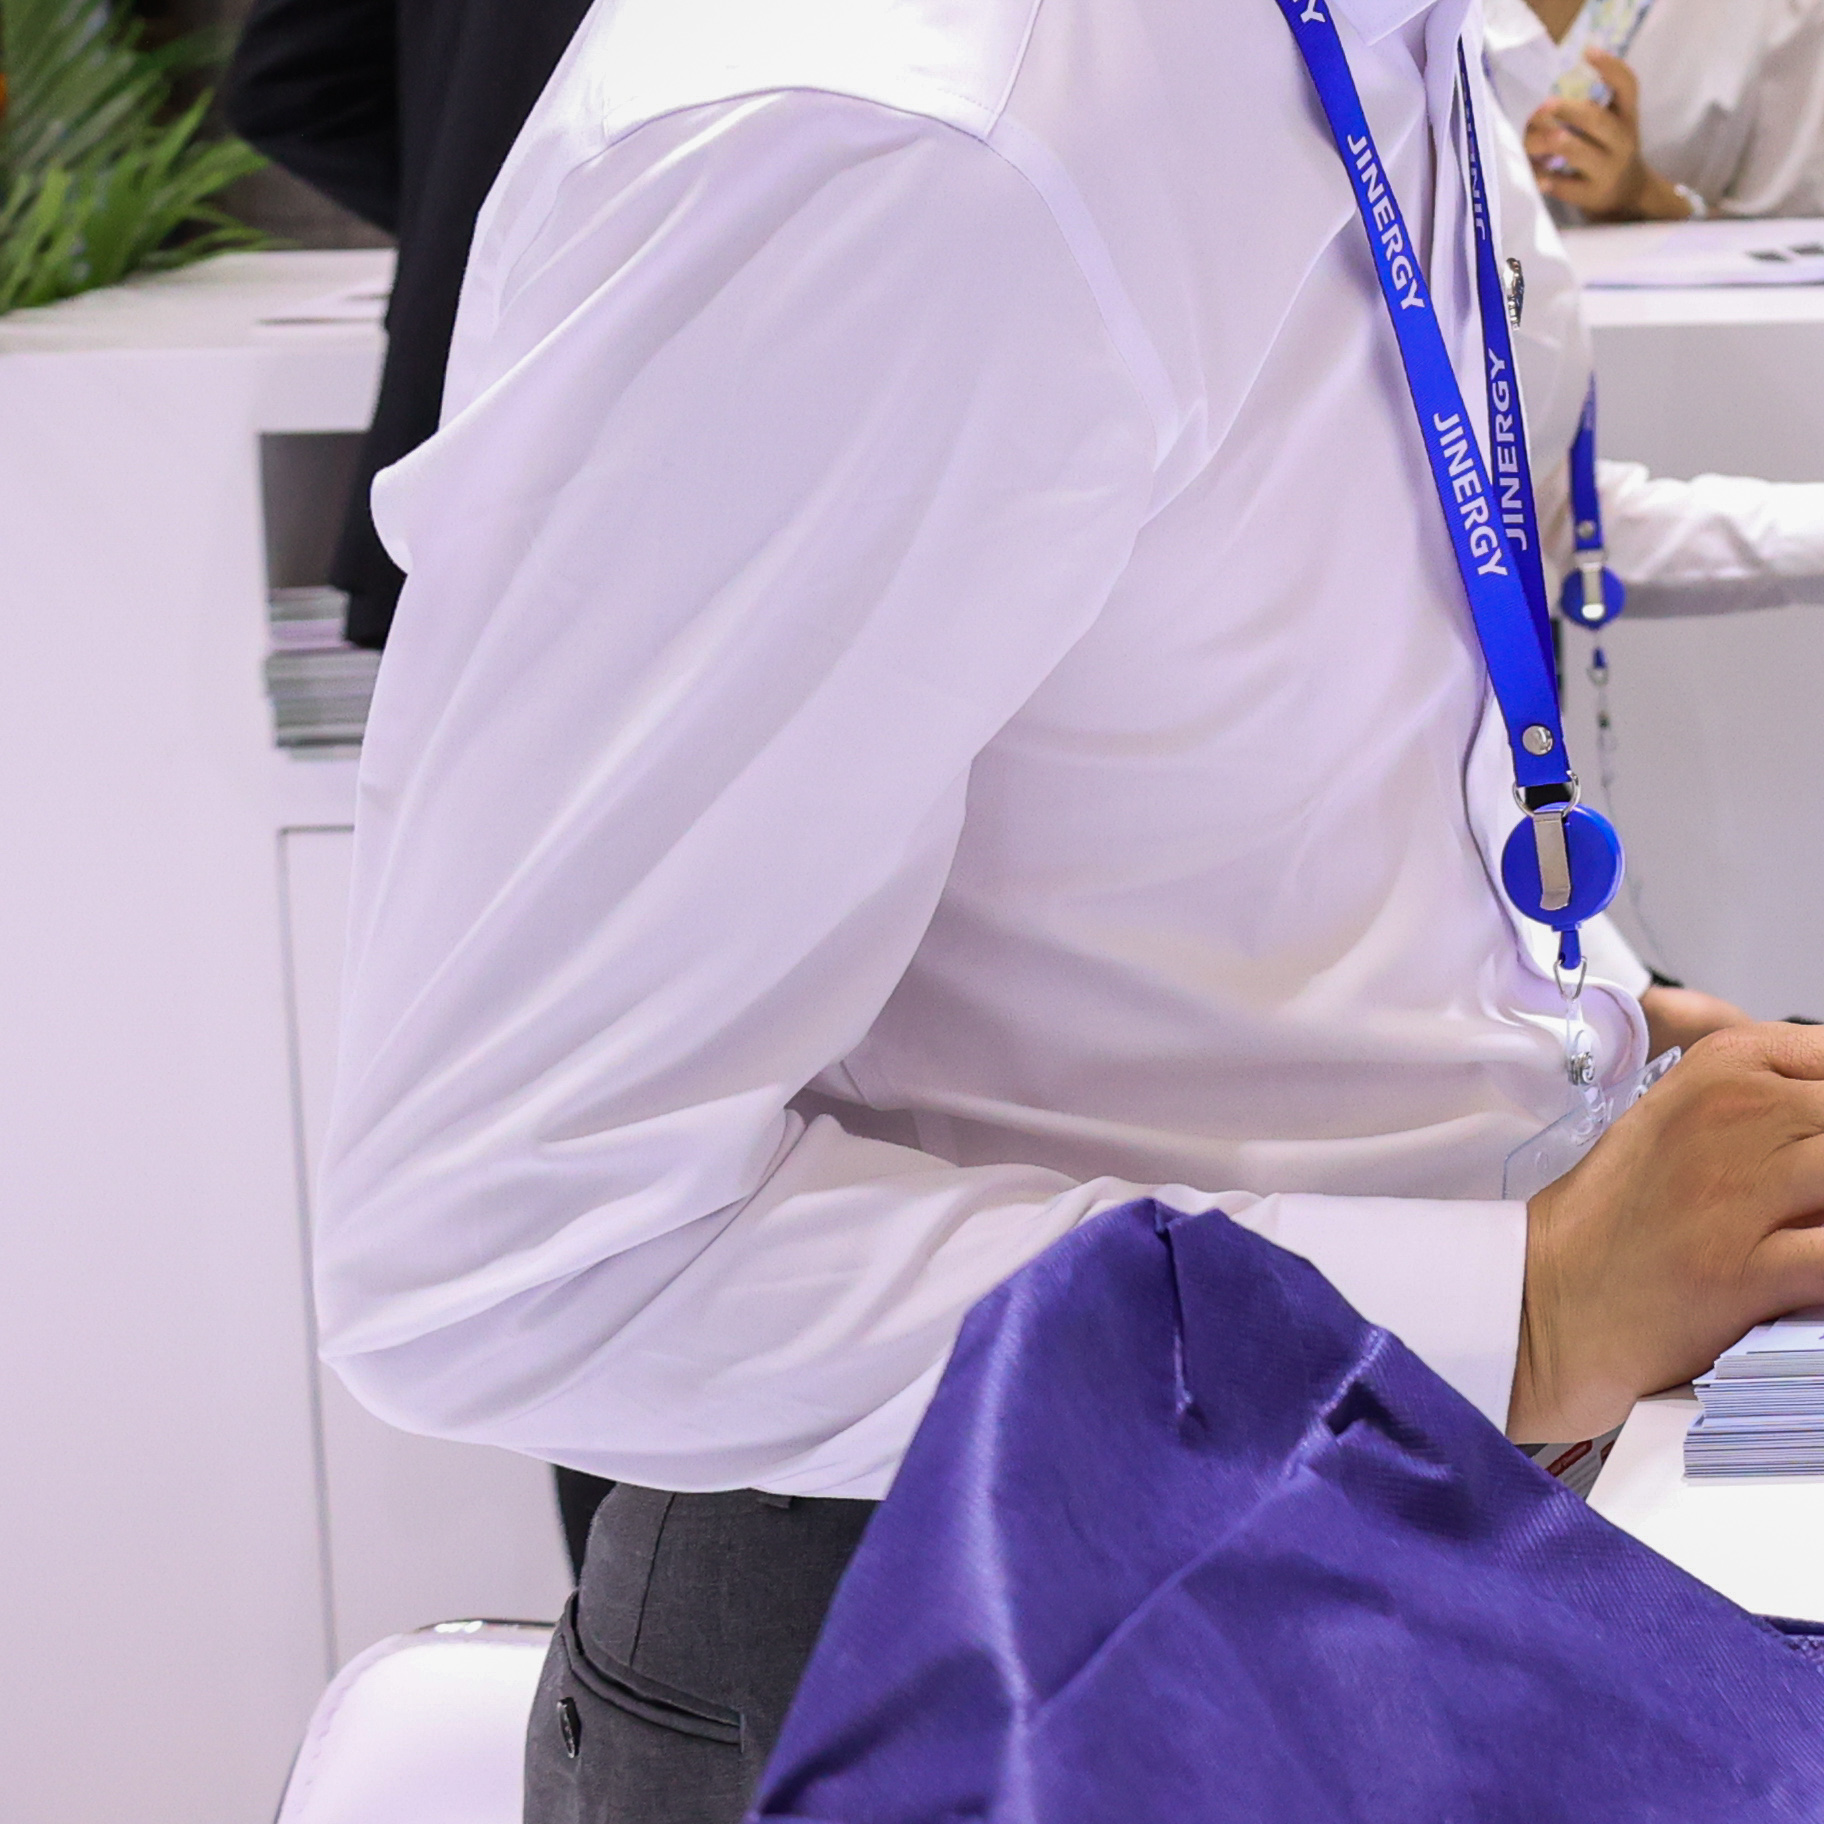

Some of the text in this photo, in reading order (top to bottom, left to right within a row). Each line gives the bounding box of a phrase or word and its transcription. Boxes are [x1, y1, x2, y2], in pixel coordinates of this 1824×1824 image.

[1347, 134, 1426, 311] JINERGY
[1433, 412, 1508, 576] JINERGY
[1488, 347, 1527, 552] JINERGY
